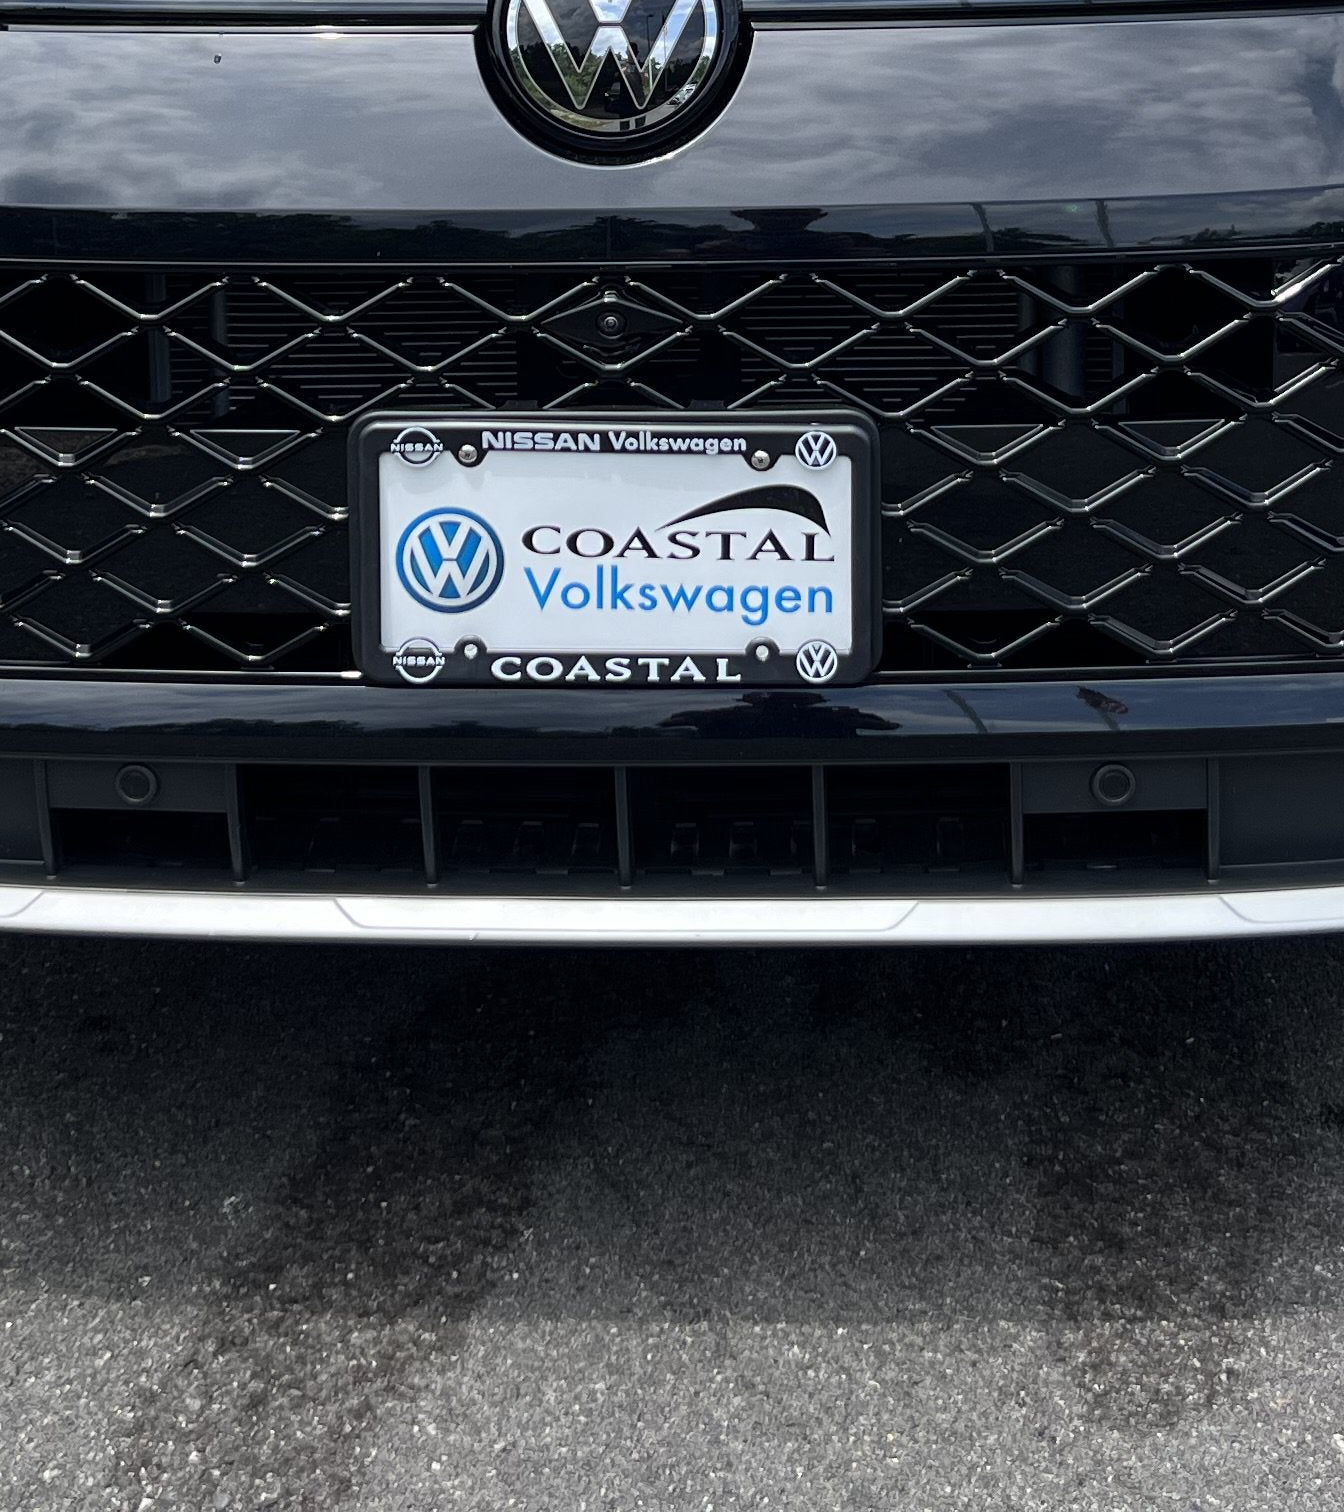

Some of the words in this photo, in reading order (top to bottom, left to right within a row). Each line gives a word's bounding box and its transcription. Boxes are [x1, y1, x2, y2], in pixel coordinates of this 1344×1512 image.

[390, 442, 444, 453] NISSAN
[481, 430, 601, 451] NISSAN
[608, 430, 747, 455] Volkswagen
[521, 524, 835, 563] COASTAL
[523, 564, 834, 626] Volkswagen
[392, 655, 446, 666] NISSAN
[490, 655, 742, 682] COASTAL
